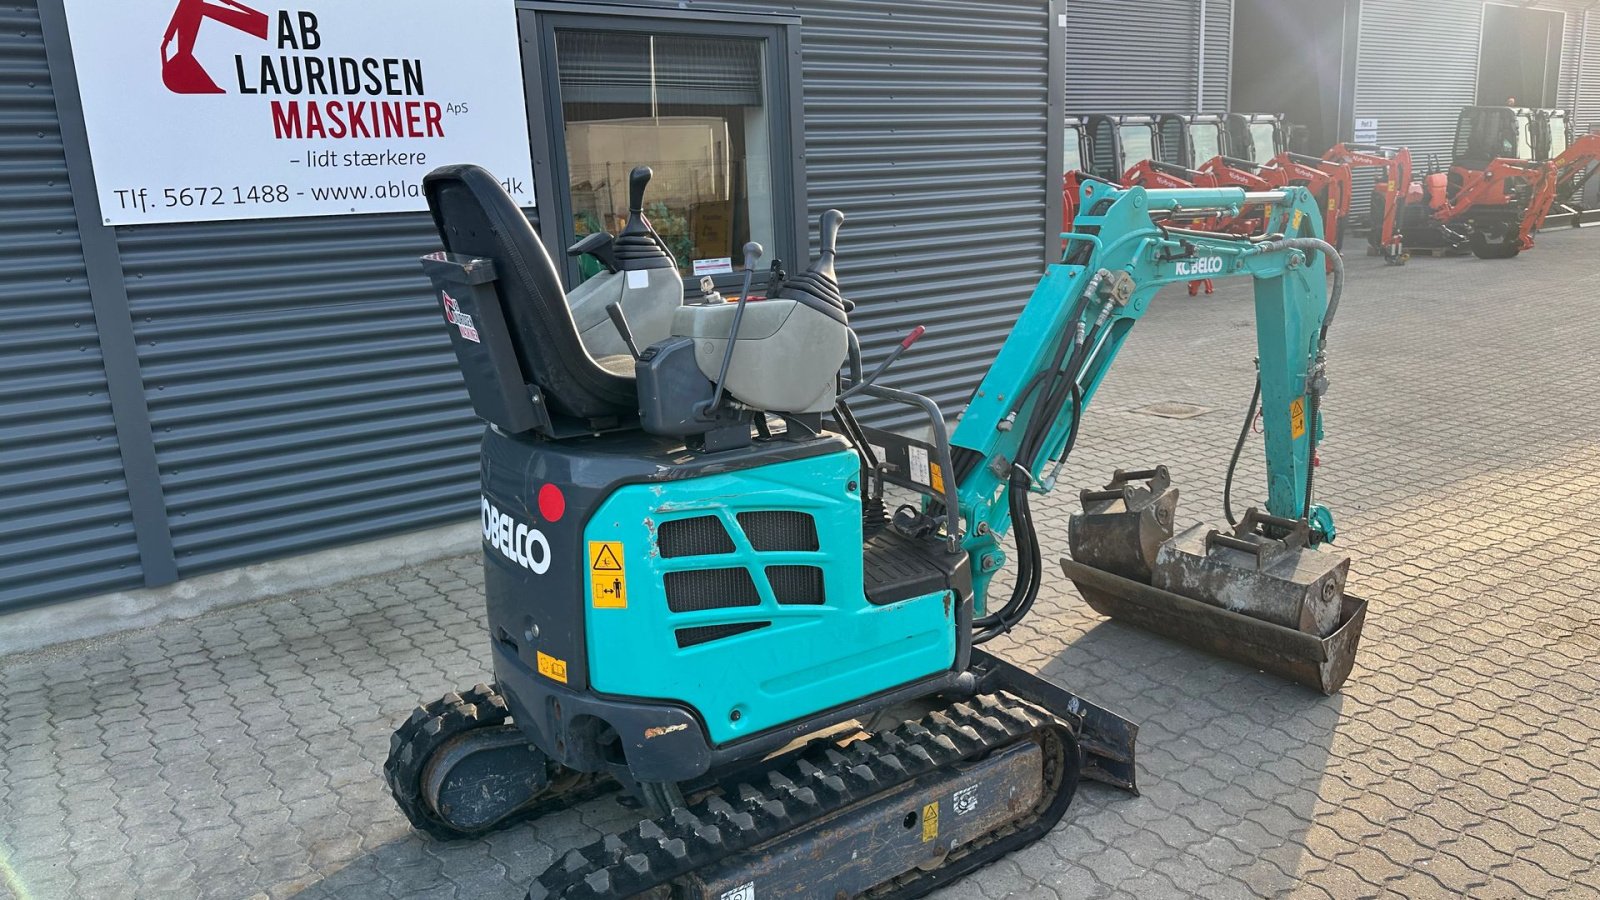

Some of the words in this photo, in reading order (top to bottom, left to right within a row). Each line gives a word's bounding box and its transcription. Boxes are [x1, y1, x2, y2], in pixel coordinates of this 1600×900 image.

[276, 9, 321, 50] AB
[234, 54, 425, 96] LAURIDSEN
[271, 100, 445, 139] MASKINER
[446, 103, 469, 116] ApS
[307, 150, 338, 167] lidt
[343, 149, 426, 166] stærkere
[113, 188, 155, 213] Tlf.
[163, 187, 225, 207] 5672
[232, 184, 289, 204] 1488
[481, 494, 551, 575] OBELCO
